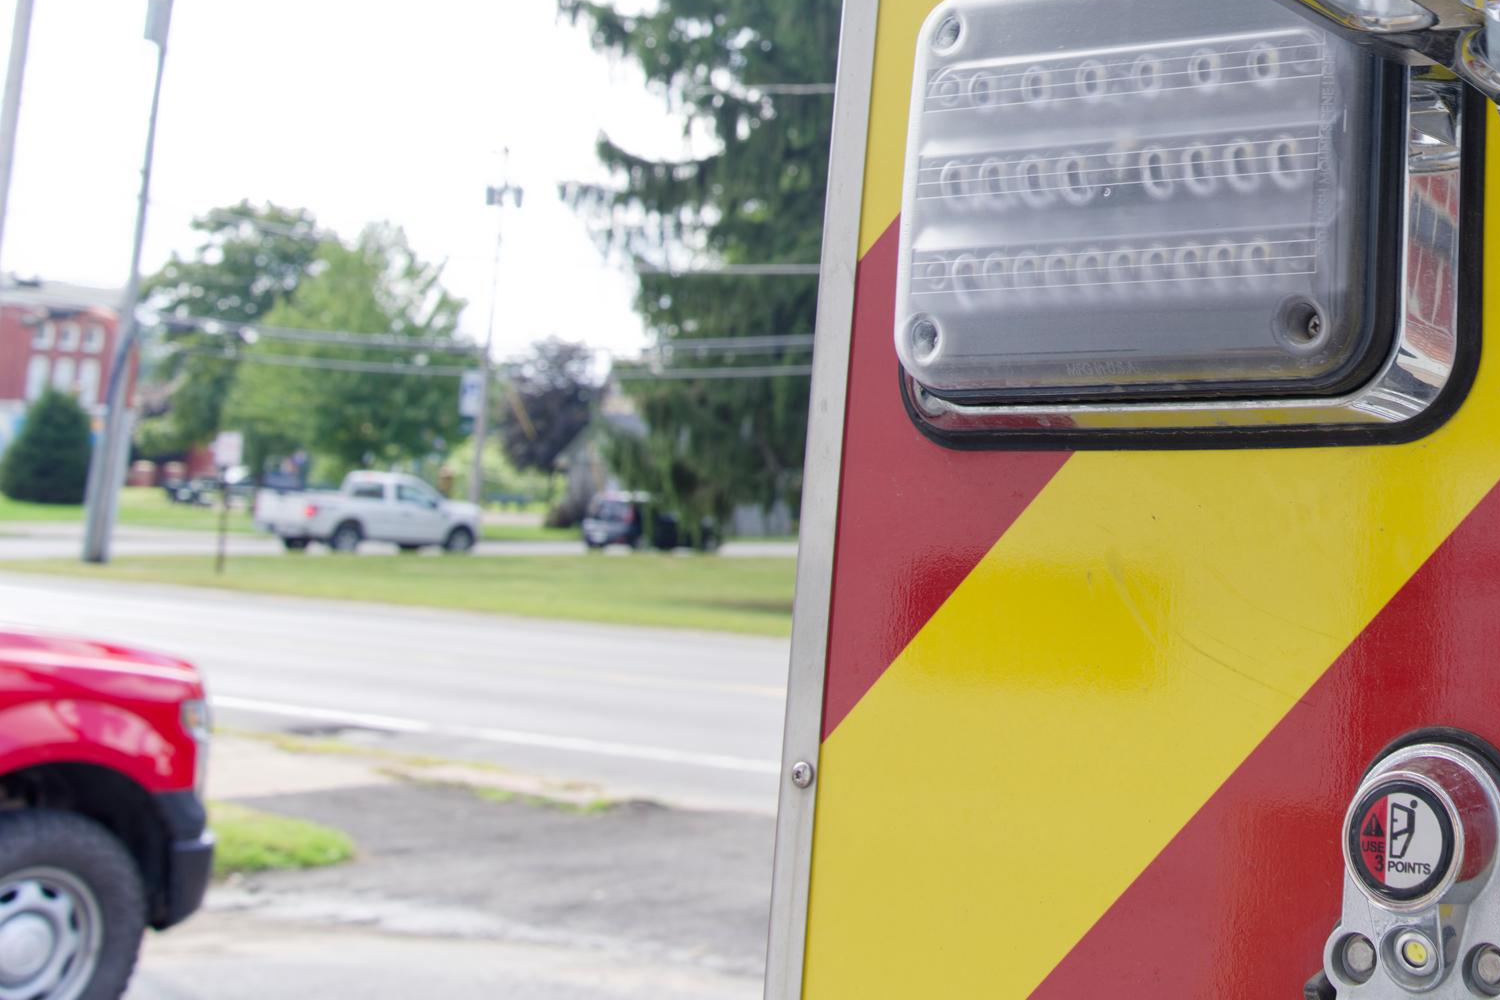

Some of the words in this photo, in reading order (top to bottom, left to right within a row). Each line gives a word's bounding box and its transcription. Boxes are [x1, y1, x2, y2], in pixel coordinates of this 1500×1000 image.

[1362, 841, 1385, 853] USE
[1374, 855, 1384, 872] 3
[1387, 861, 1432, 876] POINTS
